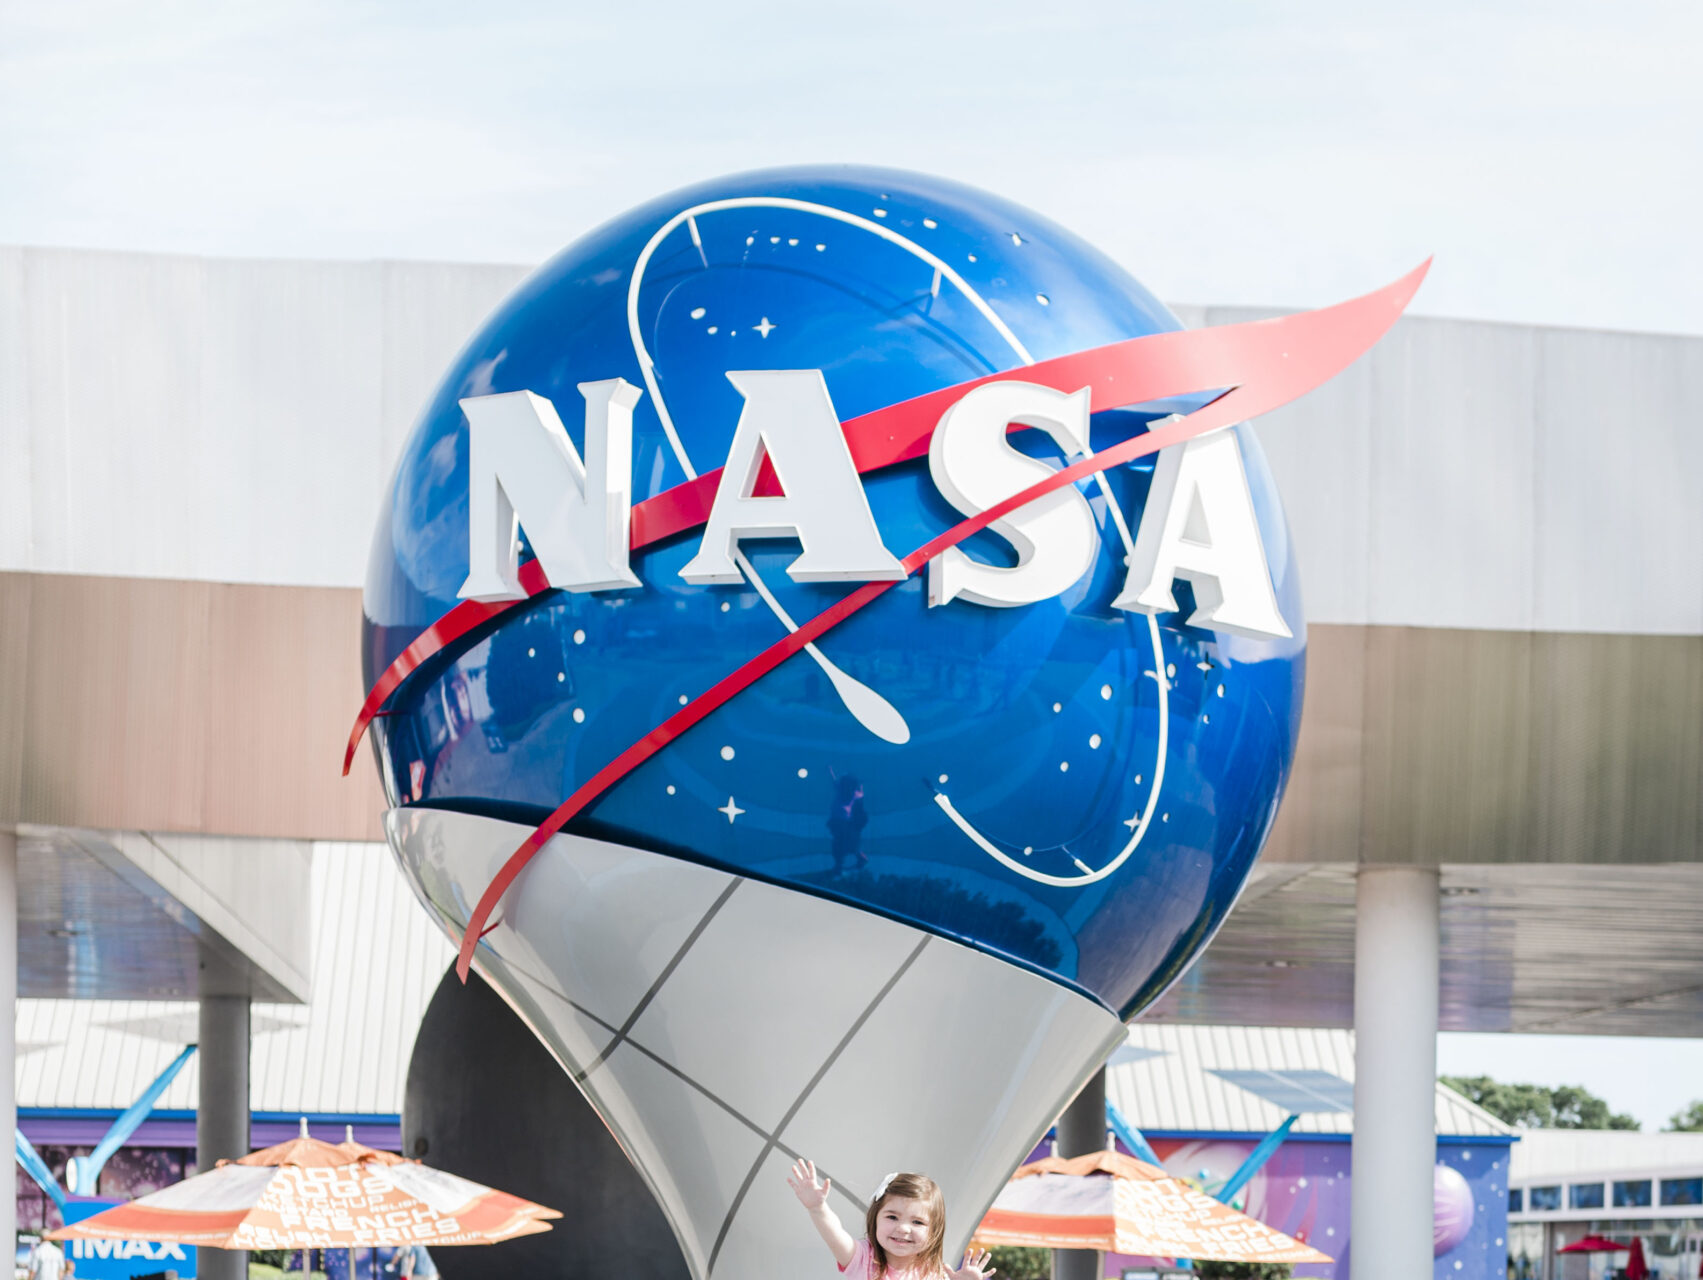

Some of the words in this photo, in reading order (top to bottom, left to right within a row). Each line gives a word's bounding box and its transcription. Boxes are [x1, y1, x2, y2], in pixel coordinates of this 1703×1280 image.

[457, 368, 1293, 639] NASA
[267, 1177, 394, 1199] DOGS
[281, 1208, 439, 1231] FRENCH
[354, 1217, 460, 1241] FRIES
[71, 1237, 187, 1260] IMAX
[1200, 1232, 1296, 1255] FRIES
